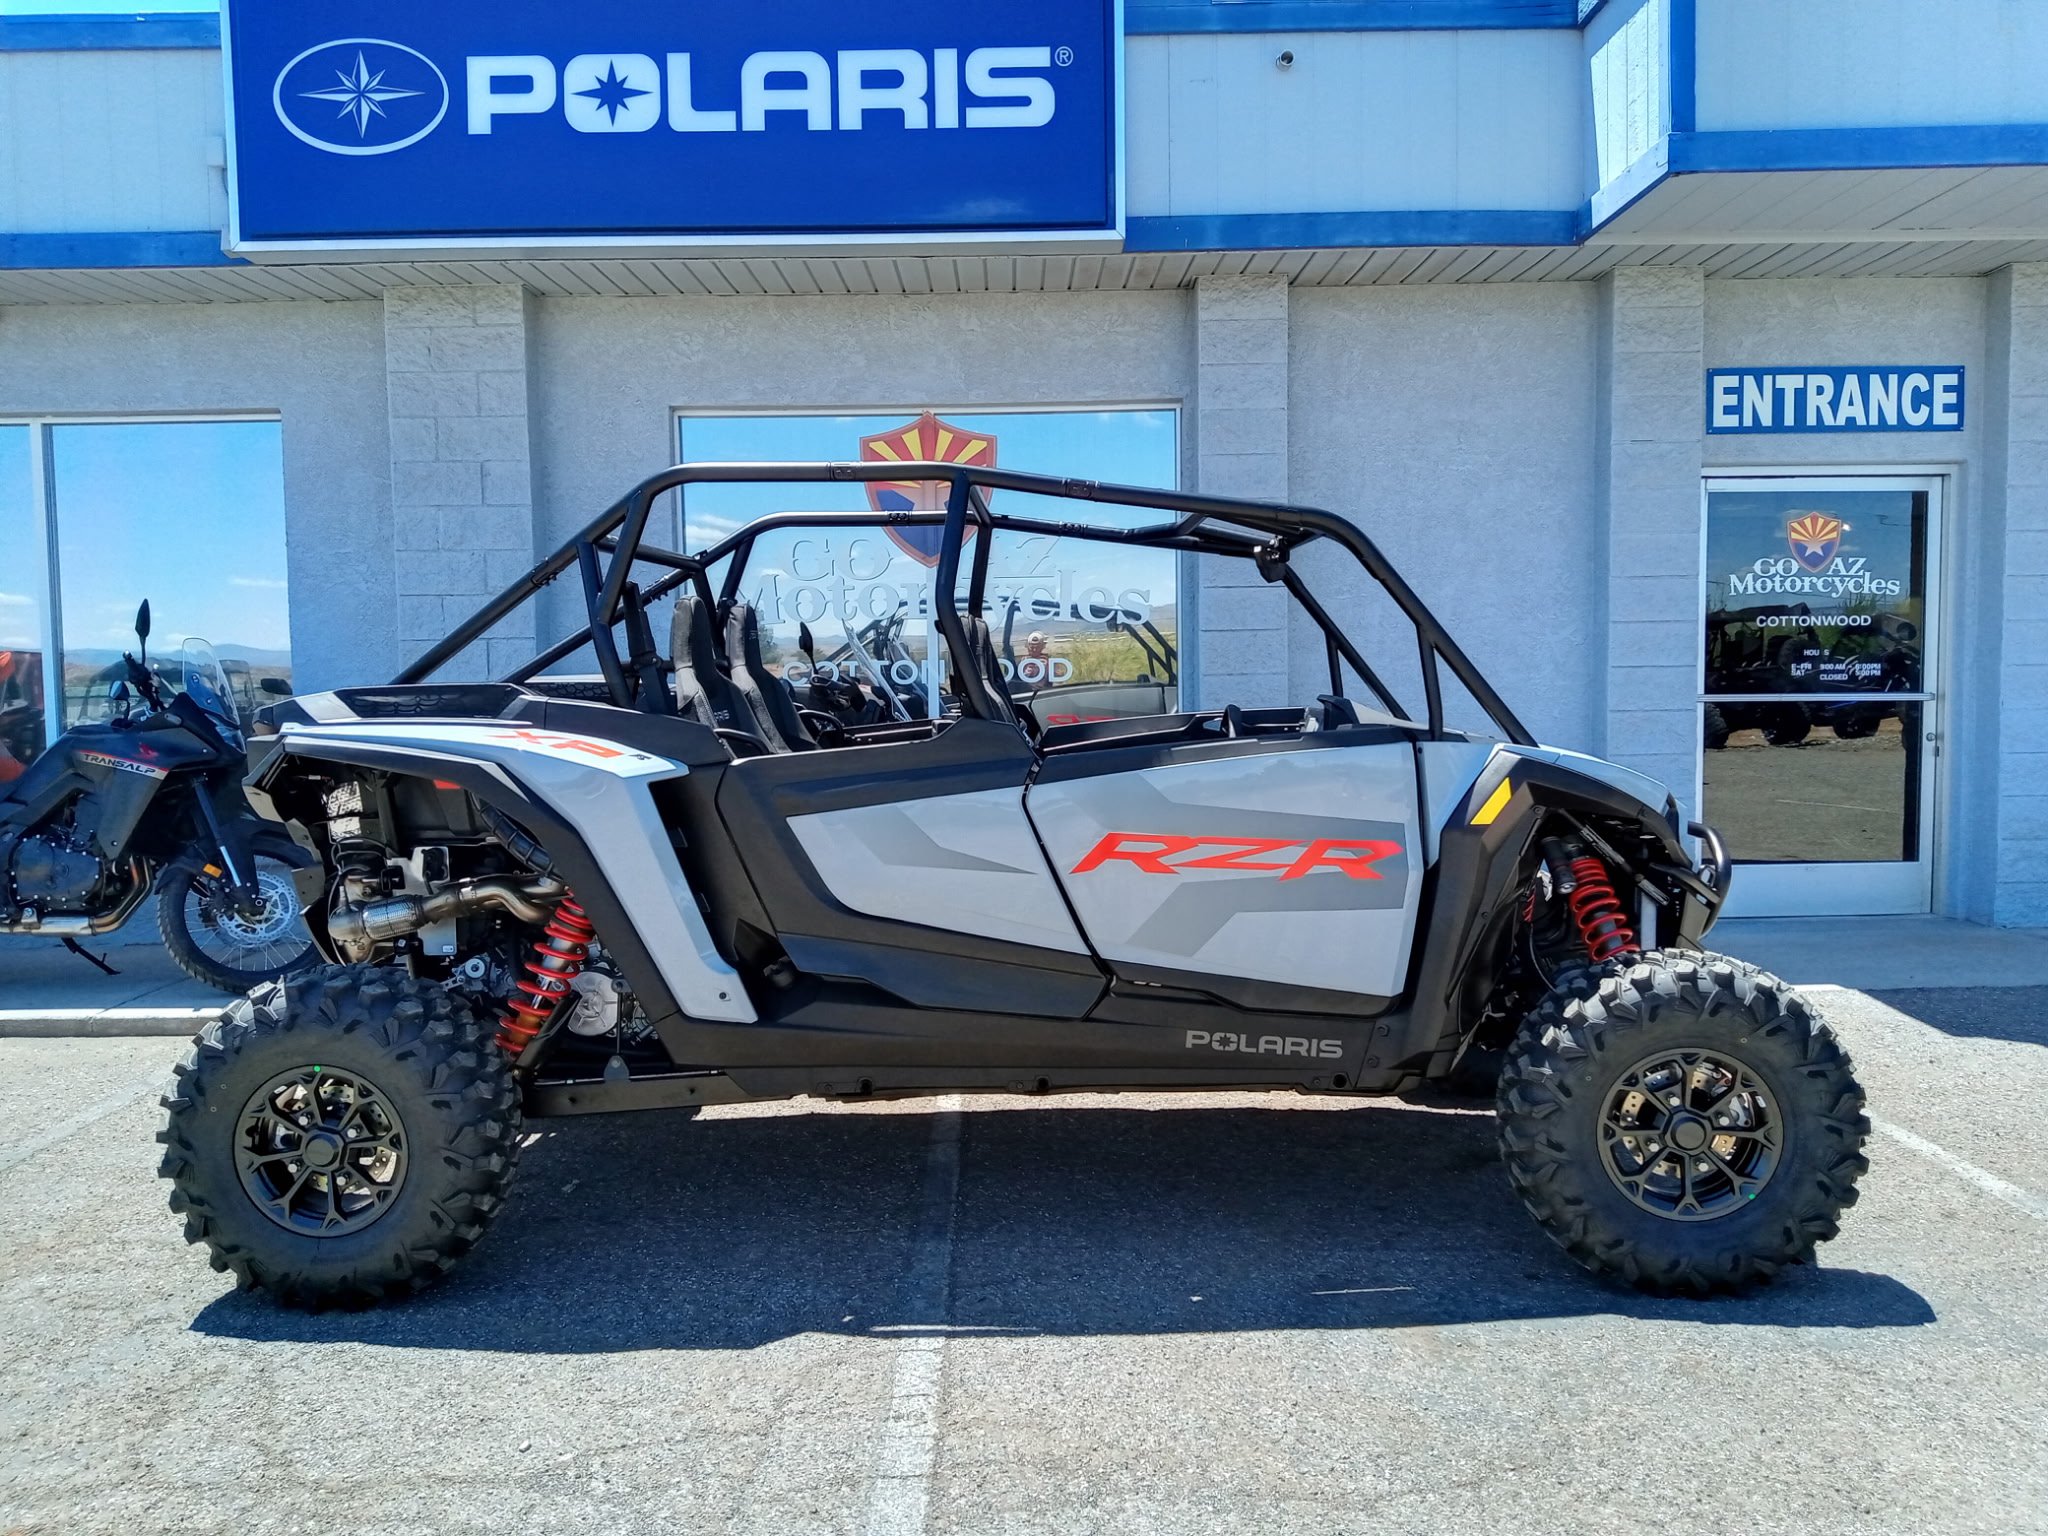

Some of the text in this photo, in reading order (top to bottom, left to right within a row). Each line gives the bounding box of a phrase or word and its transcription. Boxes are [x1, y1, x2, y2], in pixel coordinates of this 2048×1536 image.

[466, 46, 1056, 136] POLARIS
[1712, 372, 1960, 428] ENTRANCE
[777, 538, 895, 582] GO
[1752, 556, 1868, 577] GO AZ
[1728, 571, 1901, 598] Motorcycles
[1756, 615, 1872, 627] COTTONWOOD
[782, 658, 1074, 686] COTTONOOD
[84, 753, 157, 774] TRANSALP
[1068, 832, 1405, 882] RZR
[1184, 1029, 1344, 1060] POLARIS
